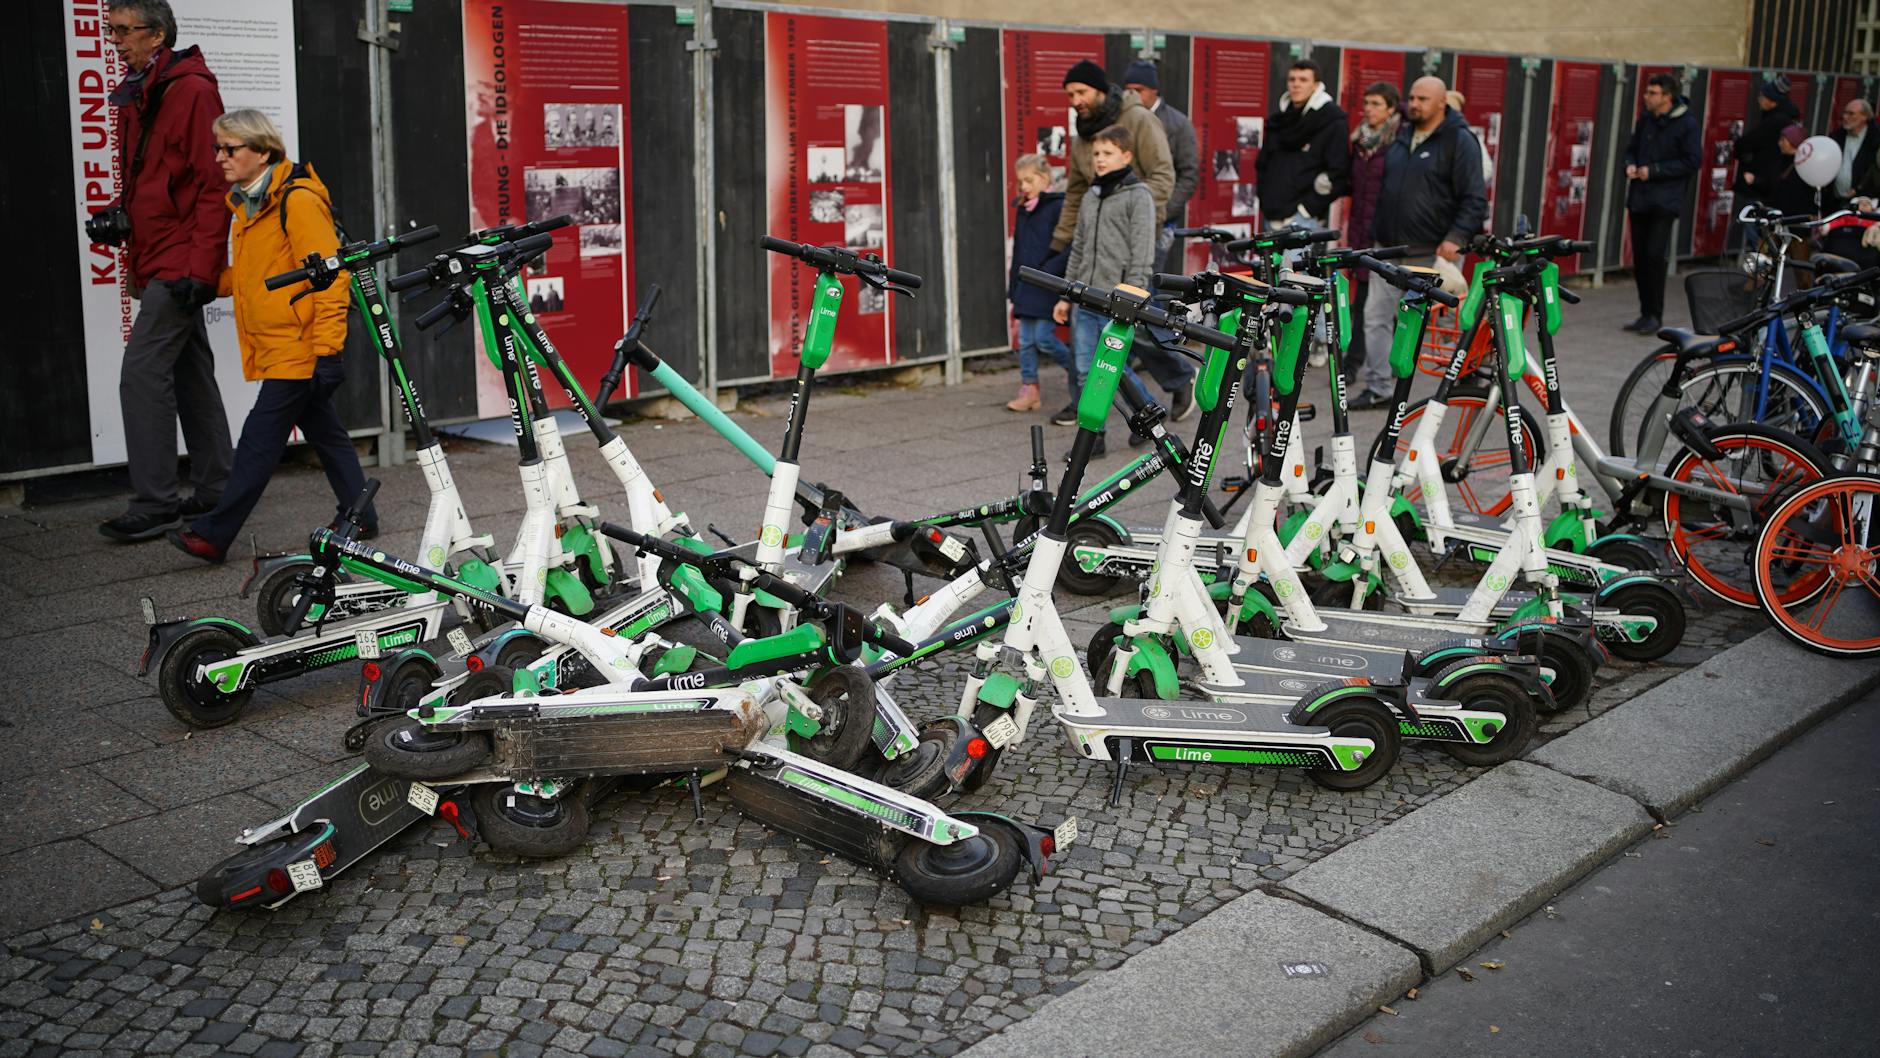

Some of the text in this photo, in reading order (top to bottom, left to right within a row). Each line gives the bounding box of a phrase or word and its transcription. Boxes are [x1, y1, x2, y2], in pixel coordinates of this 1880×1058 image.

[73, 0, 102, 58] LEI
[103, 48, 116, 75] DES
[491, 6, 506, 116] IDEOLOGEN
[788, 53, 797, 128] SEPTEMBER
[78, 69, 107, 150] UND
[496, 120, 508, 150] DIE
[789, 132, 797, 148] IM
[820, 306, 836, 318] Lime
[379, 323, 394, 349] Lime
[536, 330, 554, 354] Lime
[791, 313, 800, 358] ERSTES
[1325, 321, 1333, 345] Lime
[504, 335, 516, 362] Lime
[1096, 359, 1117, 373] Lime
[1445, 349, 1467, 382] Lime
[1544, 358, 1559, 391] Lime
[1226, 381, 1240, 409] Lime
[1337, 374, 1348, 410] Lime
[1388, 401, 1408, 438] Lime
[1507, 405, 1523, 445] Lime
[1270, 420, 1291, 458] Lime
[1188, 438, 1213, 487] Lime
[1088, 491, 1113, 510] Lime
[959, 508, 975, 519] Lime
[394, 558, 421, 575] Lime
[646, 608, 668, 626] Lime
[359, 632, 376, 644] 162
[383, 632, 413, 648] Lime
[448, 631, 465, 643] 845
[710, 617, 729, 644] Lime
[954, 625, 977, 640] Lime
[360, 645, 377, 657] WPT
[667, 672, 705, 691] Lime
[653, 702, 695, 711] Lime
[1180, 708, 1234, 723] Lime
[997, 717, 1016, 737] 798
[1174, 747, 1213, 762] Lime
[409, 785, 424, 806] 738
[797, 776, 831, 795] Lime
[290, 865, 308, 889] WPK
[303, 864, 320, 885] 875
